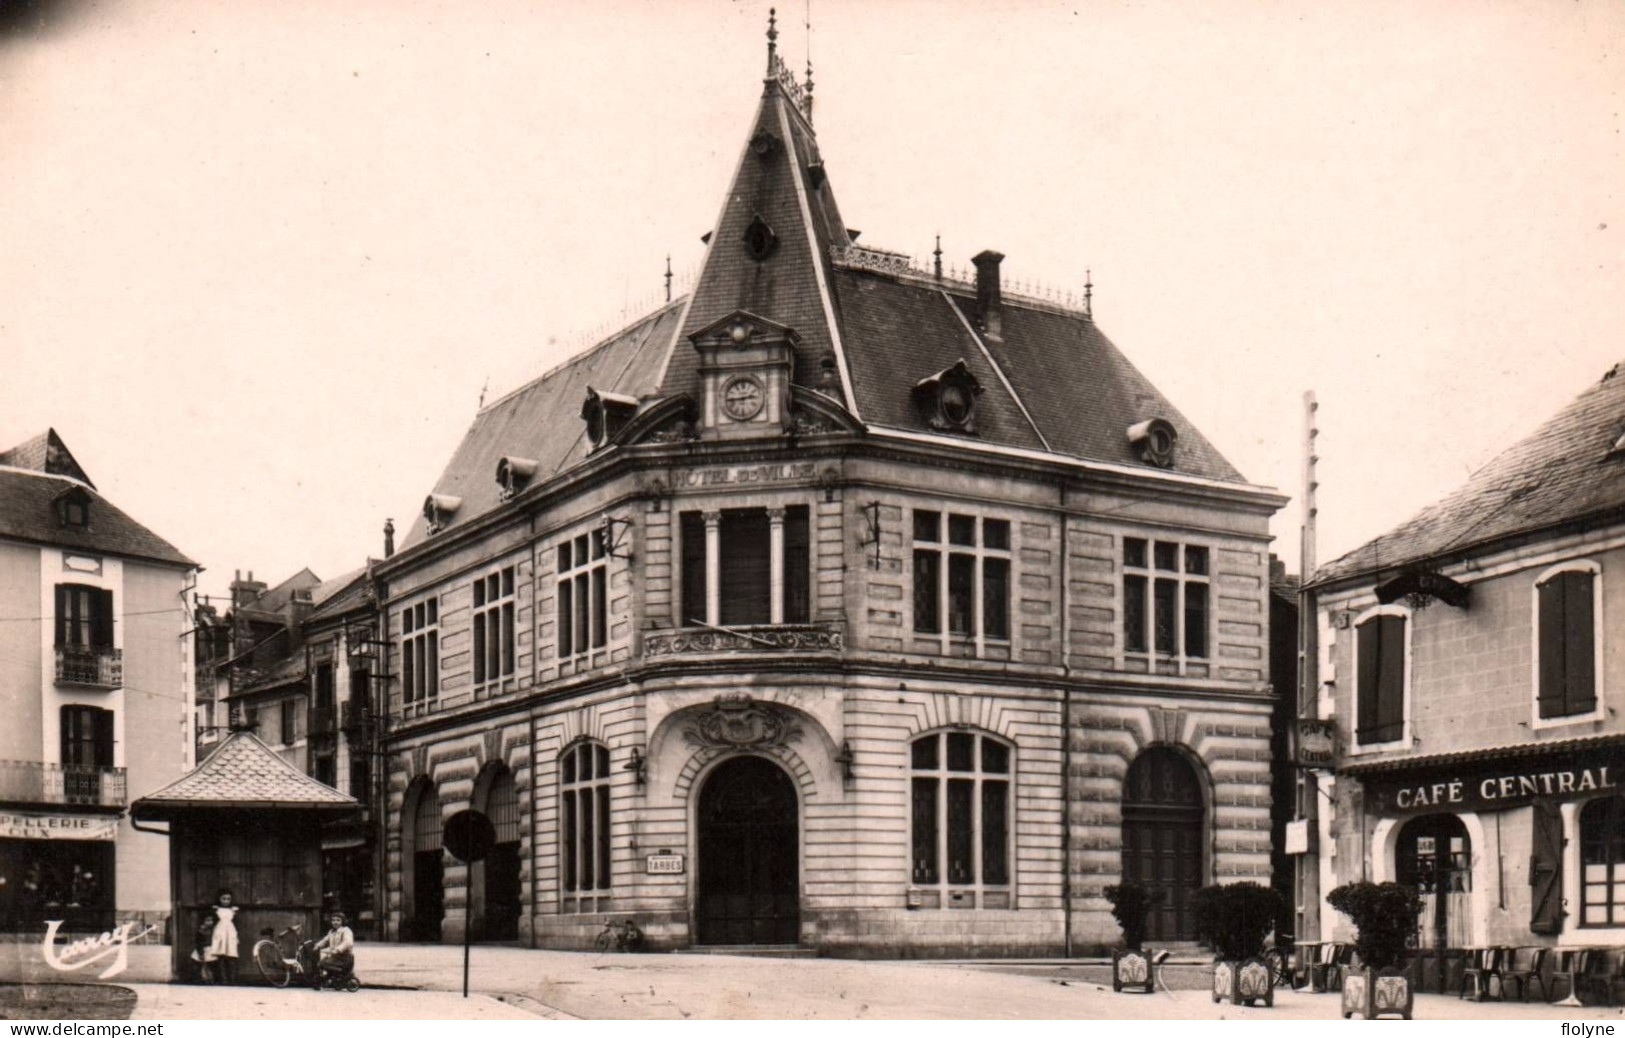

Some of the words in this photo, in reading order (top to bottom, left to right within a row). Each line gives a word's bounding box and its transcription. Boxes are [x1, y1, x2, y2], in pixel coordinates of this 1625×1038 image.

[1397, 778, 1464, 808] CAFÉ
[1480, 767, 1616, 799] CENTRAL
[649, 861, 682, 871] TARBES
